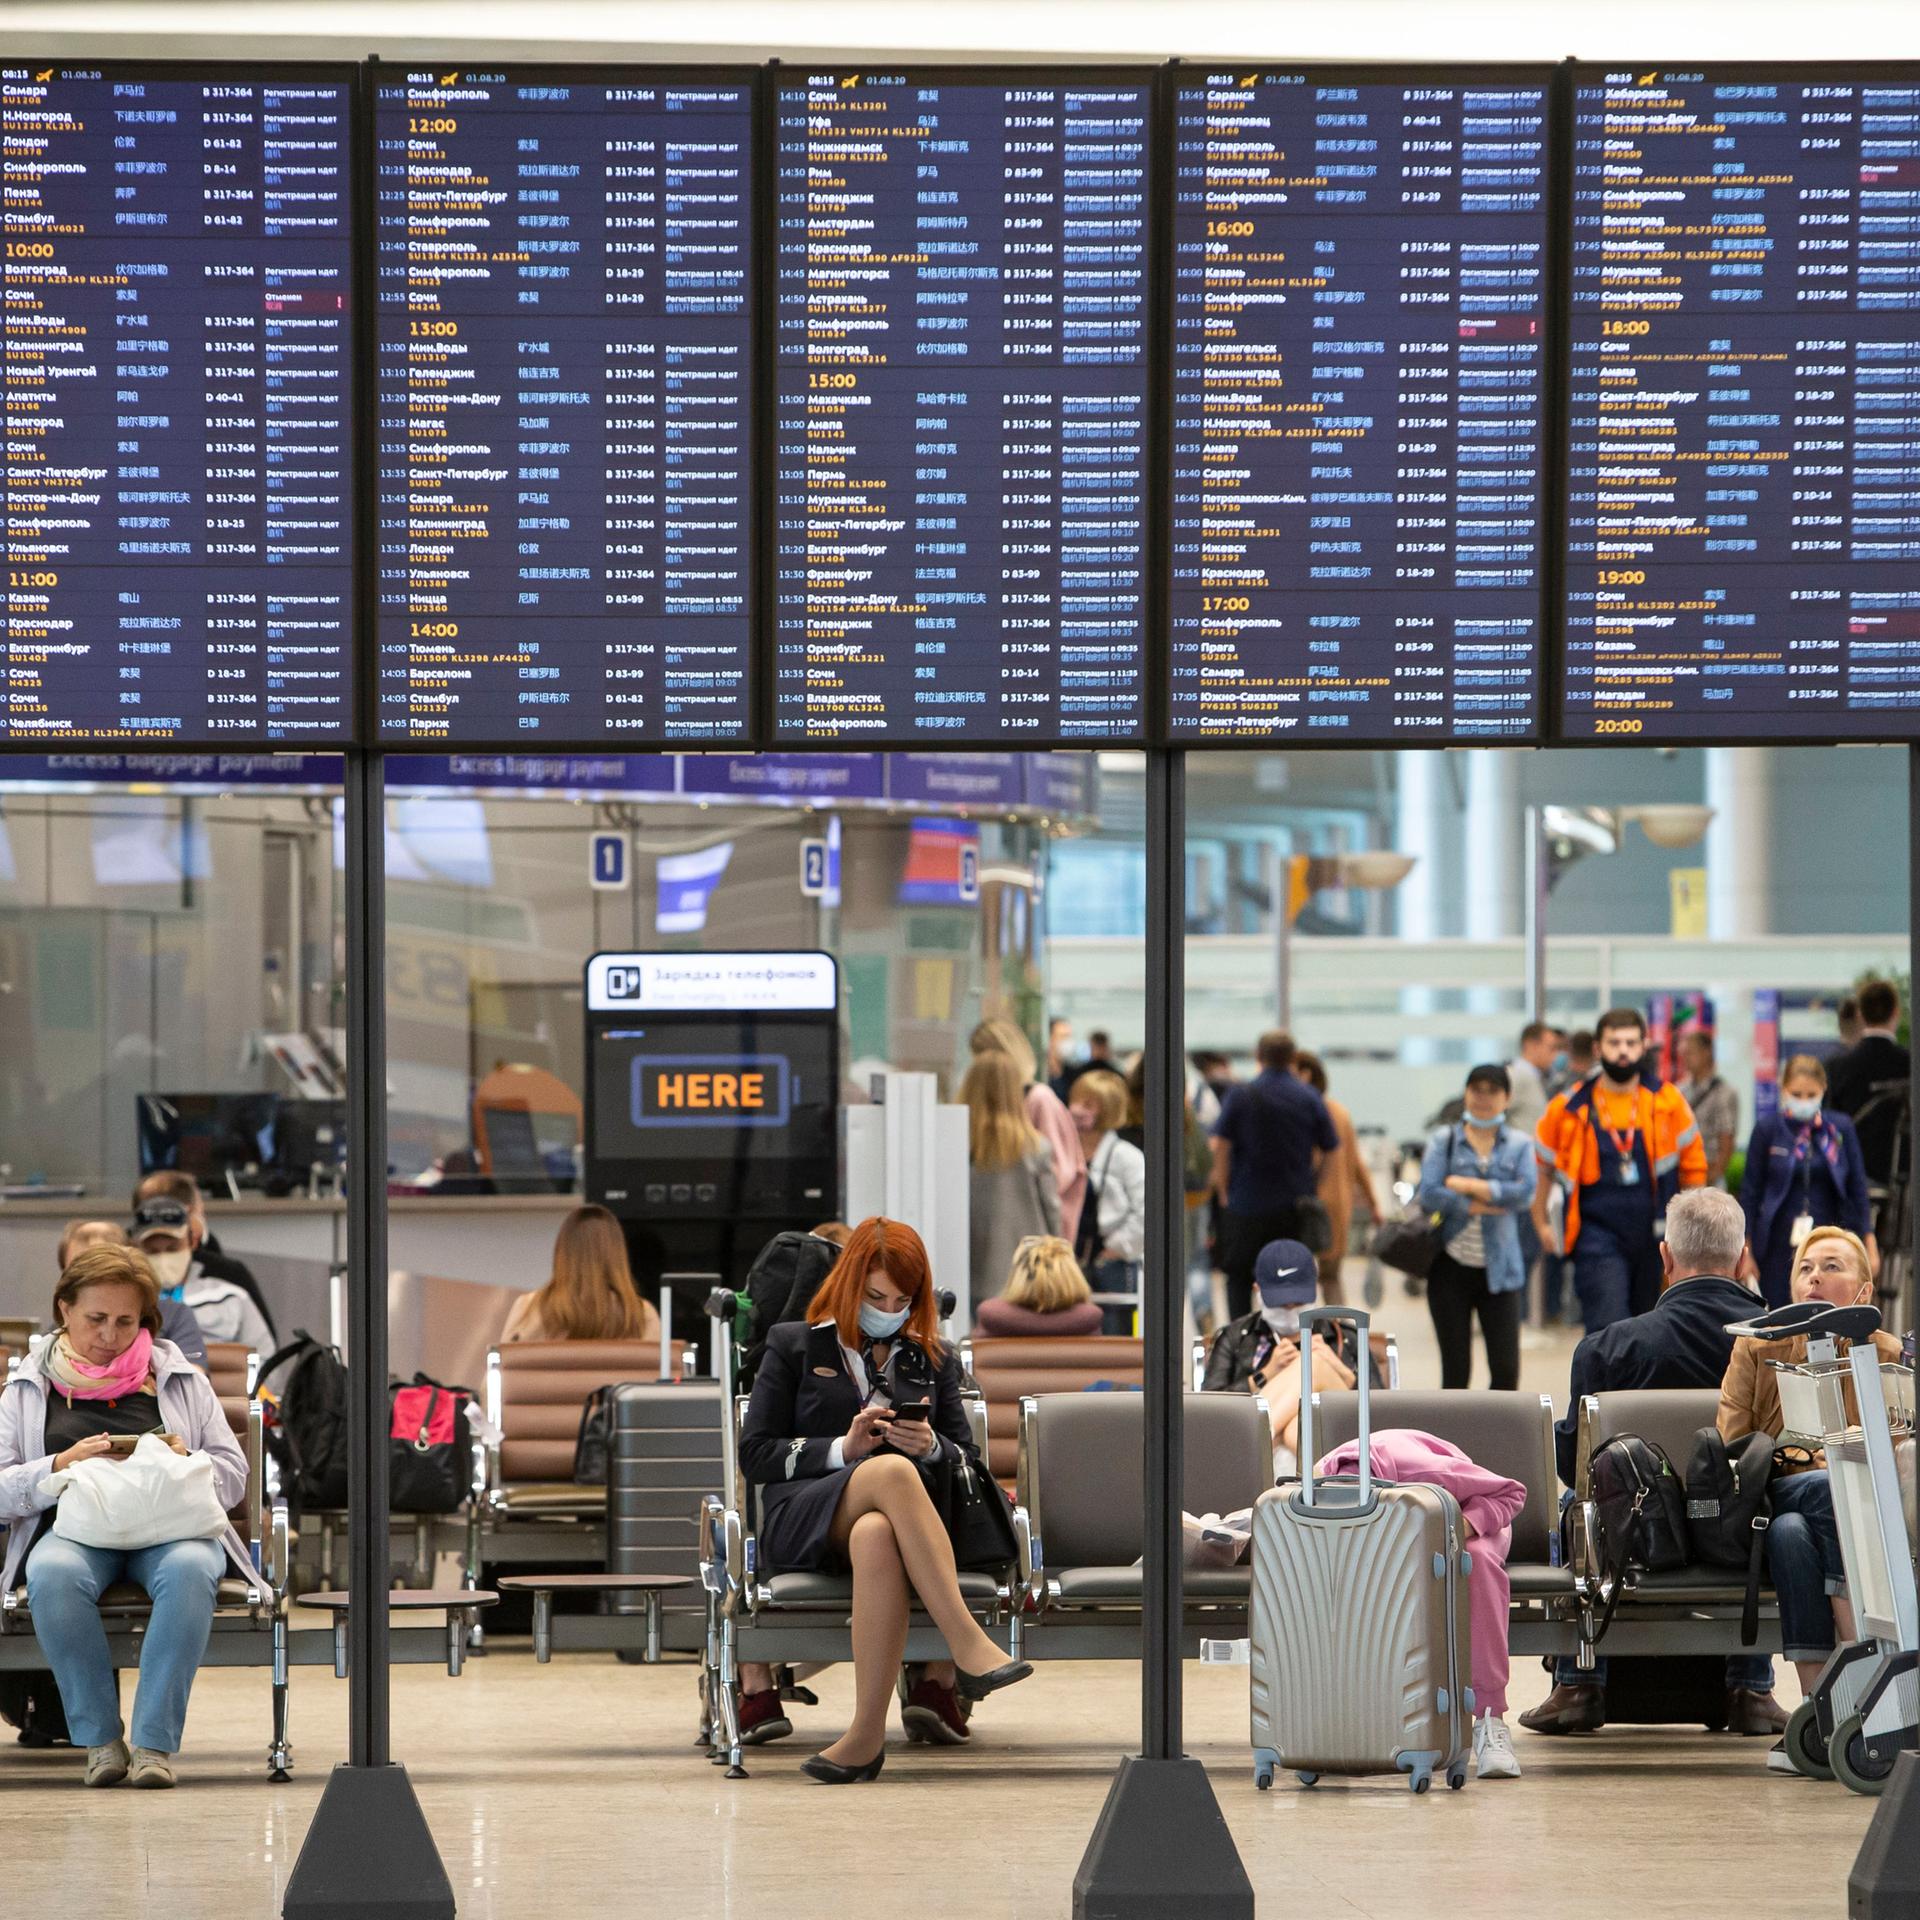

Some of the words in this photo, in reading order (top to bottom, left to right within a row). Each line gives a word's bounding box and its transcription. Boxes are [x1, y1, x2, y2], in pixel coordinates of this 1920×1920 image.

[2, 70, 28, 78] 08:15
[62, 71, 101, 79] 01.08.20
[407, 74, 433, 82] 08:15
[3, 85, 47, 97] Самара
[213, 88, 252, 97] 317-364
[380, 89, 404, 98] 11:45
[408, 89, 489, 102] Симферополь
[3, 111, 72, 123] Н.Новгород
[409, 118, 456, 133] 12:00
[3, 136, 48, 148] Лондон
[380, 140, 405, 149] 12:20
[408, 140, 436, 150] Сочи
[4, 162, 86, 174] Симферополь
[214, 165, 236, 173] 8-14
[409, 165, 472, 178] Краснодар
[4, 188, 39, 198] Пенза
[408, 191, 507, 204] Санкт-Петербург
[5, 213, 54, 225] Стамбул
[1208, 222, 1254, 236] 16:00
[7, 243, 54, 257] 10:00
[5, 264, 67, 277] Волгоград
[6, 290, 34, 299] Сочи
[6, 315, 65, 326] Мин.Воды
[411, 321, 457, 336] 13:00
[1603, 321, 1649, 335] 18:00
[6, 341, 84, 353] Калининград
[381, 343, 406, 352] 13:00
[409, 343, 467, 355] Мин.Воды
[7, 366, 45, 378] Новый
[48, 366, 96, 378] Уренгой
[409, 368, 475, 380] Геленджик
[809, 373, 856, 388] 15:00
[6, 392, 56, 401] Апатиты
[216, 393, 243, 402] 40-41
[7, 417, 64, 429] Белгород
[381, 419, 406, 427] 13:25
[409, 419, 444, 428] Магас
[8, 467, 107, 480] Санкт-Петербург
[8, 493, 100, 505] Ростов-на-Дону
[409, 494, 453, 505] Самара
[8, 518, 90, 530] Симферополь
[410, 519, 486, 531] Калининград
[8, 543, 69, 555] Ульяновск
[382, 545, 406, 553] 13:55
[409, 544, 454, 556] Лондон
[9, 572, 57, 587] 11:00
[410, 569, 470, 578] Ульяновск
[1599, 571, 1645, 584] 19:00
[9, 593, 49, 603] Казань
[410, 594, 446, 606] Ницца
[1203, 597, 1249, 611] 17:00
[9, 618, 73, 630] Краснодар
[412, 623, 458, 637] 14:00
[9, 643, 90, 655] Екатеринбург
[409, 644, 455, 653] Тюмень
[615, 645, 654, 653] 317-364
[9, 669, 38, 678] Сочи
[410, 669, 471, 681] Барселона
[9, 718, 72, 728] Челябинск
[410, 719, 449, 730] Париж
[616, 719, 643, 727] 83-99
[1596, 720, 1642, 733] 20:00
[125, 755, 214, 775] baggage
[218, 756, 304, 775] payment
[603, 845, 614, 874] 1
[809, 852, 821, 881] 2
[658, 1074, 764, 1108] HERE
